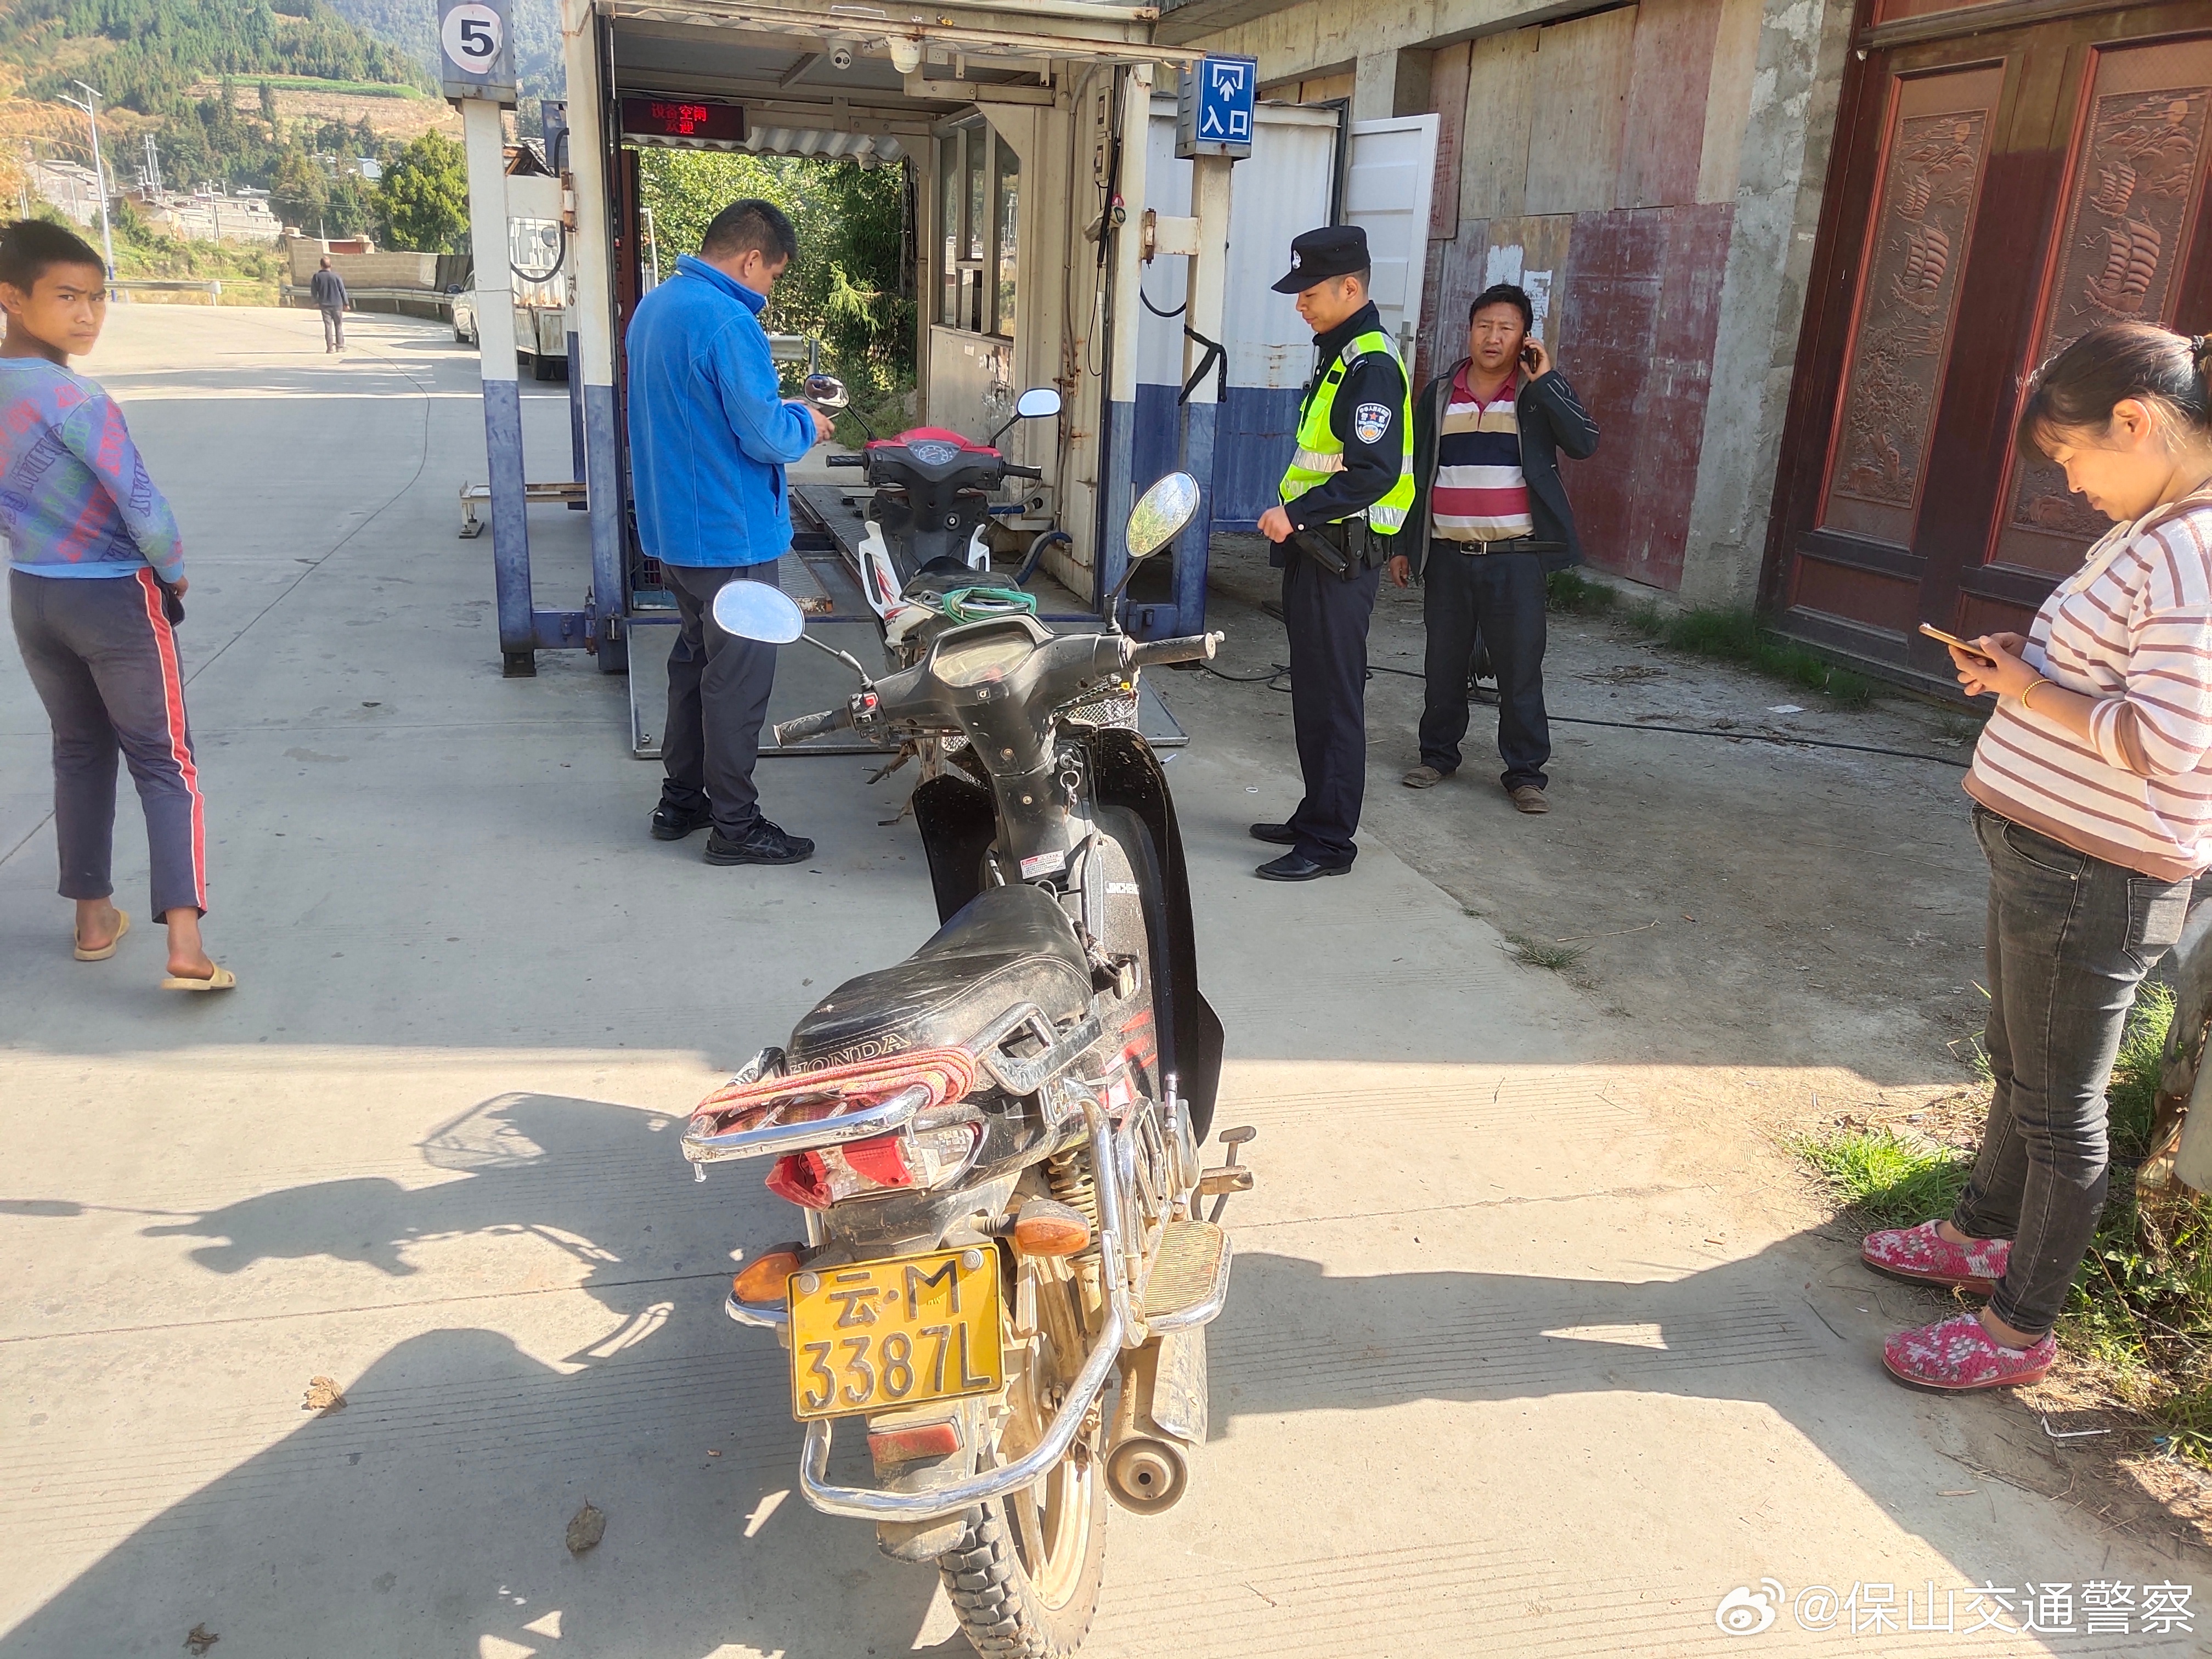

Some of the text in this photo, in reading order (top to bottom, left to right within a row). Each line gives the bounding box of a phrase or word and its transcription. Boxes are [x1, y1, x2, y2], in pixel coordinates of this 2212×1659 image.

[461, 19, 494, 57] 5
[665, 119, 695, 134] 欢迎
[1201, 105, 1248, 136] 入口
[790, 1033, 912, 1075] HONDA
[804, 1321, 991, 1408] 3387L
